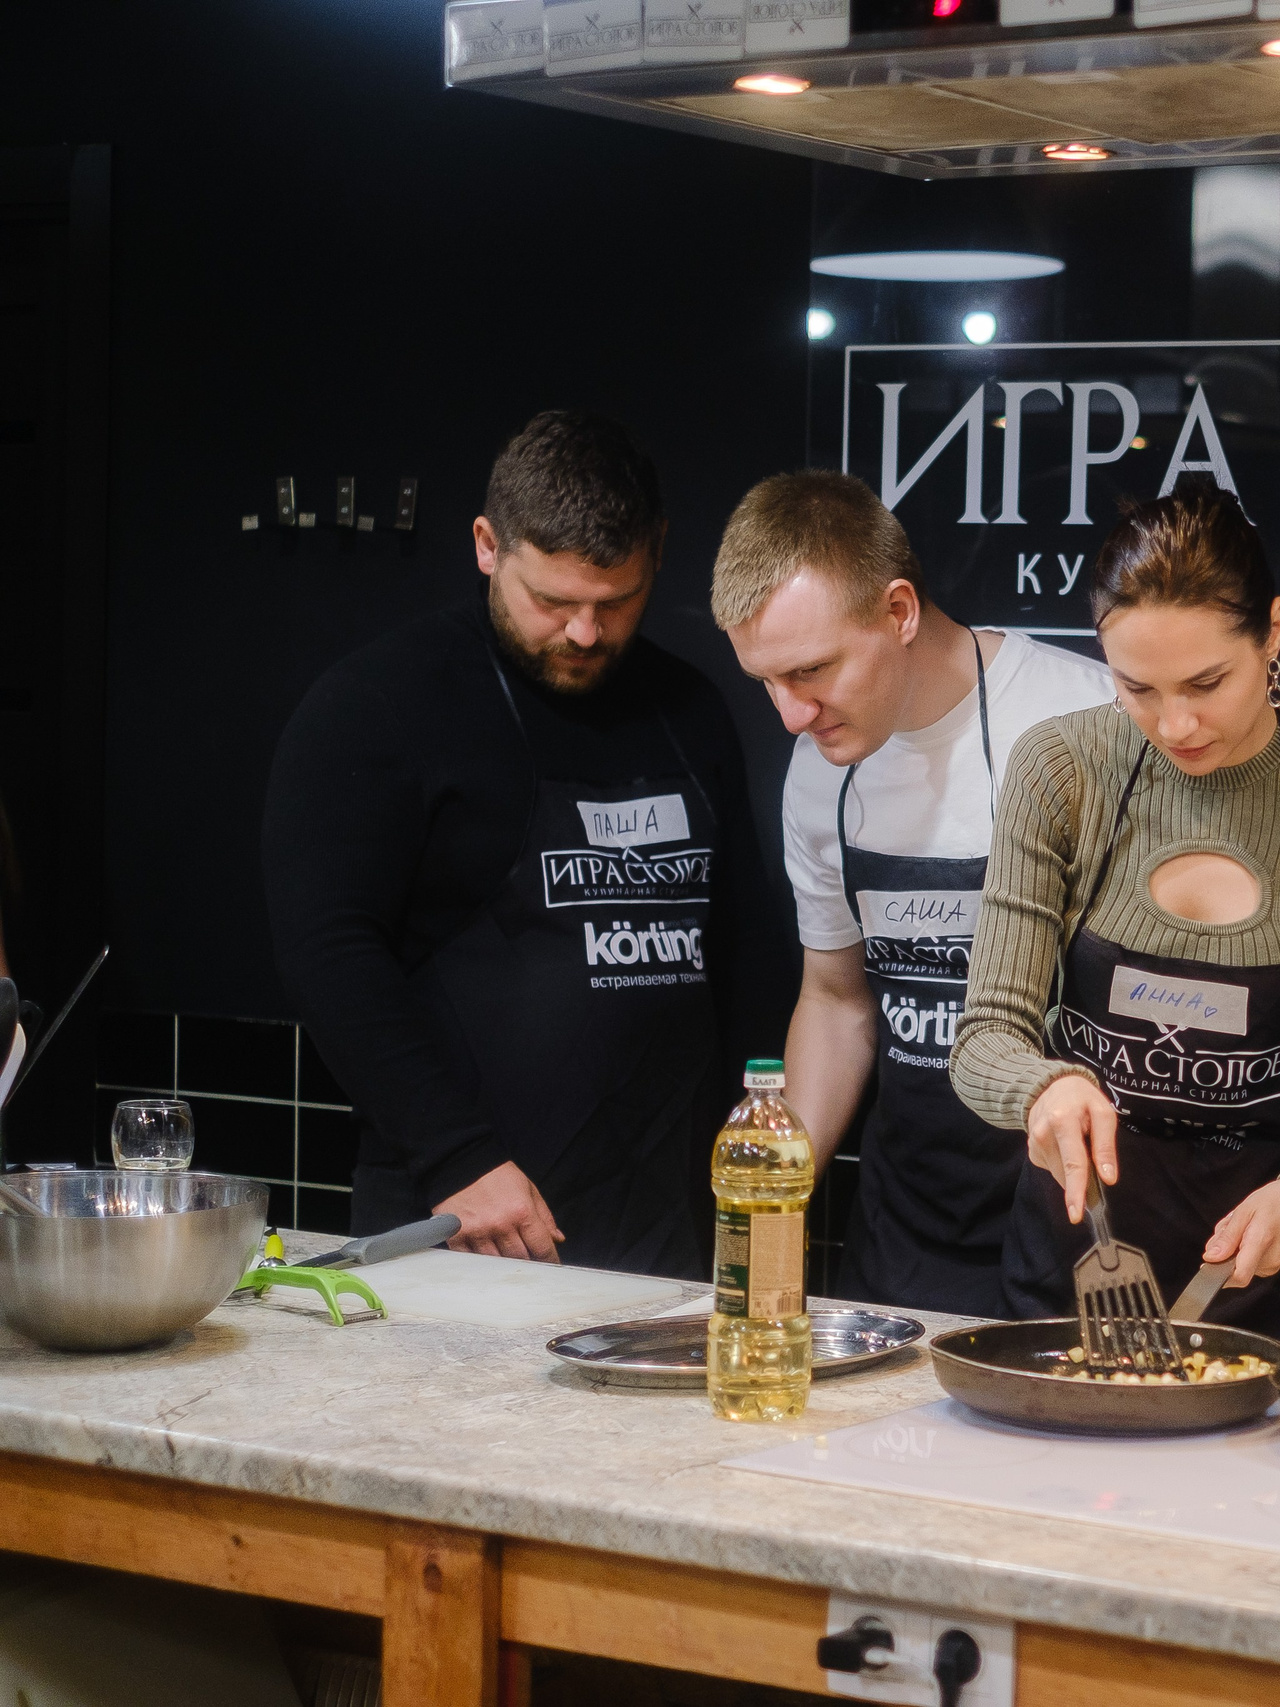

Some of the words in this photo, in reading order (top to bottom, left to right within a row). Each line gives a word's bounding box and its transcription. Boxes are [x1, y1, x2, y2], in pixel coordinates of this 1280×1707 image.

[876, 381, 1257, 526] ИГРА
[593, 804, 659, 840] ПАША
[550, 857, 624, 886] ИГРА
[885, 897, 968, 924] САША
[584, 921, 704, 971] körting
[591, 973, 677, 990] встраиваемая
[878, 962, 951, 975] КУЛИНАРНАЯ
[1066, 1014, 1135, 1075] ИГРА
[1102, 1066, 1181, 1094] ЛИНАРНАЯ
[1189, 1088, 1248, 1102] СТУДИЯ
